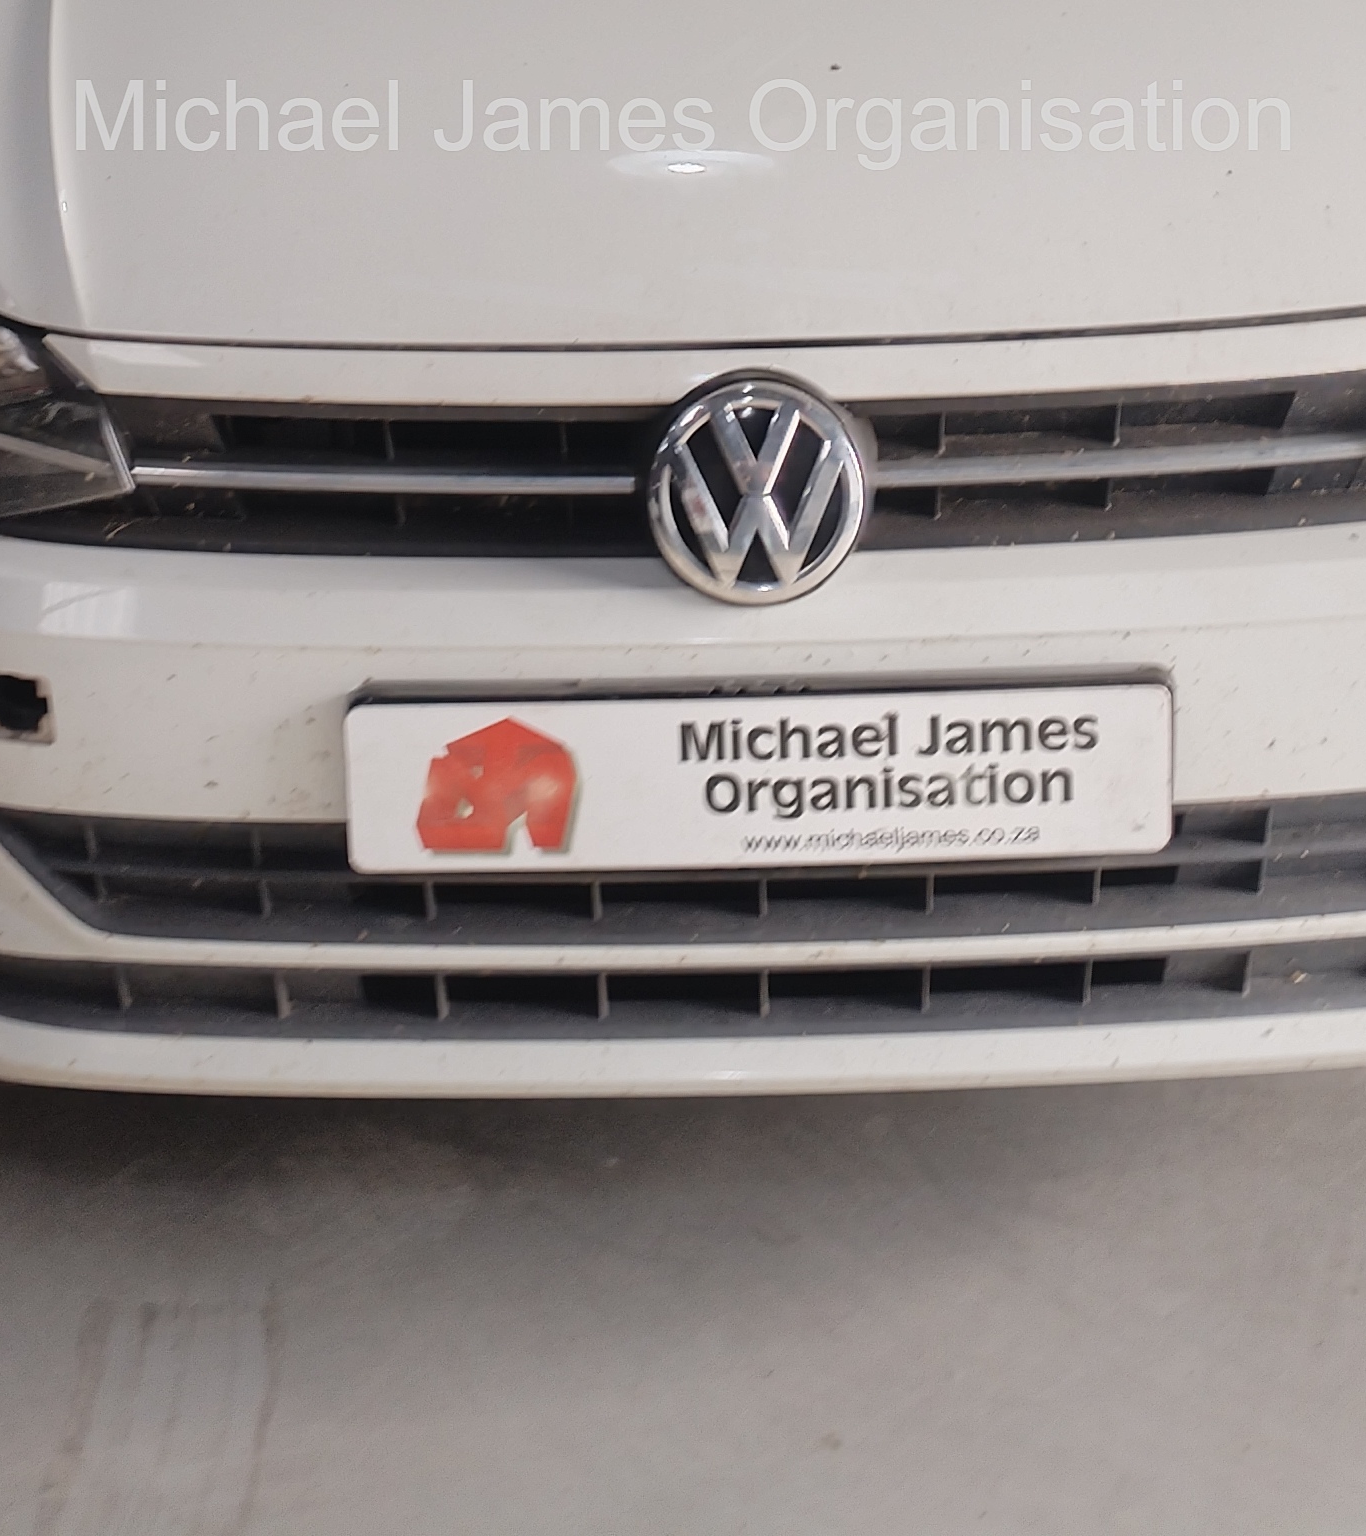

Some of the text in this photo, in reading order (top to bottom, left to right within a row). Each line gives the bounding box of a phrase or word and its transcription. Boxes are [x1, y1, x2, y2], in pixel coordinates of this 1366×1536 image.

[679, 712, 1097, 763] Michael James
[705, 764, 1072, 820] Organisation
[744, 827, 1039, 852] www.michaeljames.co.za
